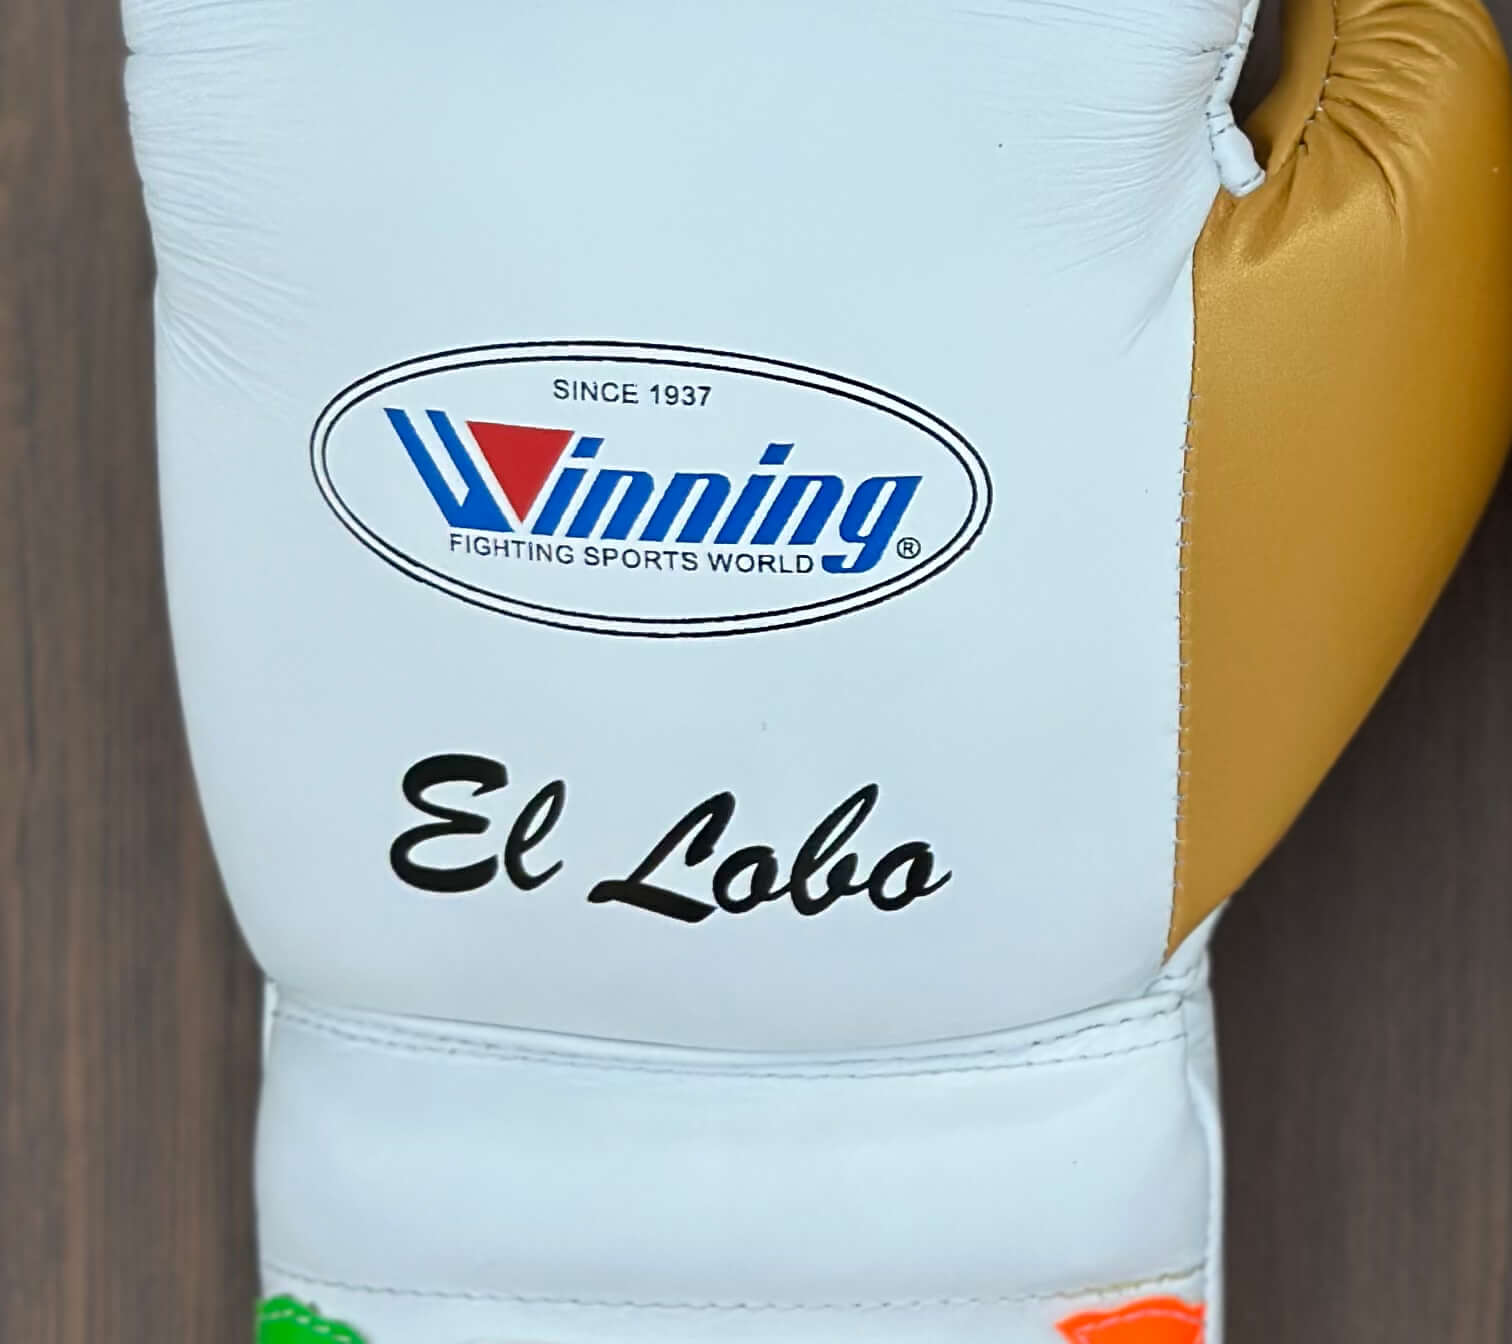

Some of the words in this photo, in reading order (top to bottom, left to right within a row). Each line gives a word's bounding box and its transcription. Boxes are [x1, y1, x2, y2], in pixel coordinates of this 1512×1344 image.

[552, 378, 640, 406] SINCE
[649, 383, 712, 407] 1937
[383, 407, 923, 574] Winning
[449, 532, 575, 565] FIGHTING
[583, 545, 698, 572] SPORTS
[707, 552, 814, 575] WORLD
[389, 752, 566, 894] El
[587, 782, 952, 923] Lobo
